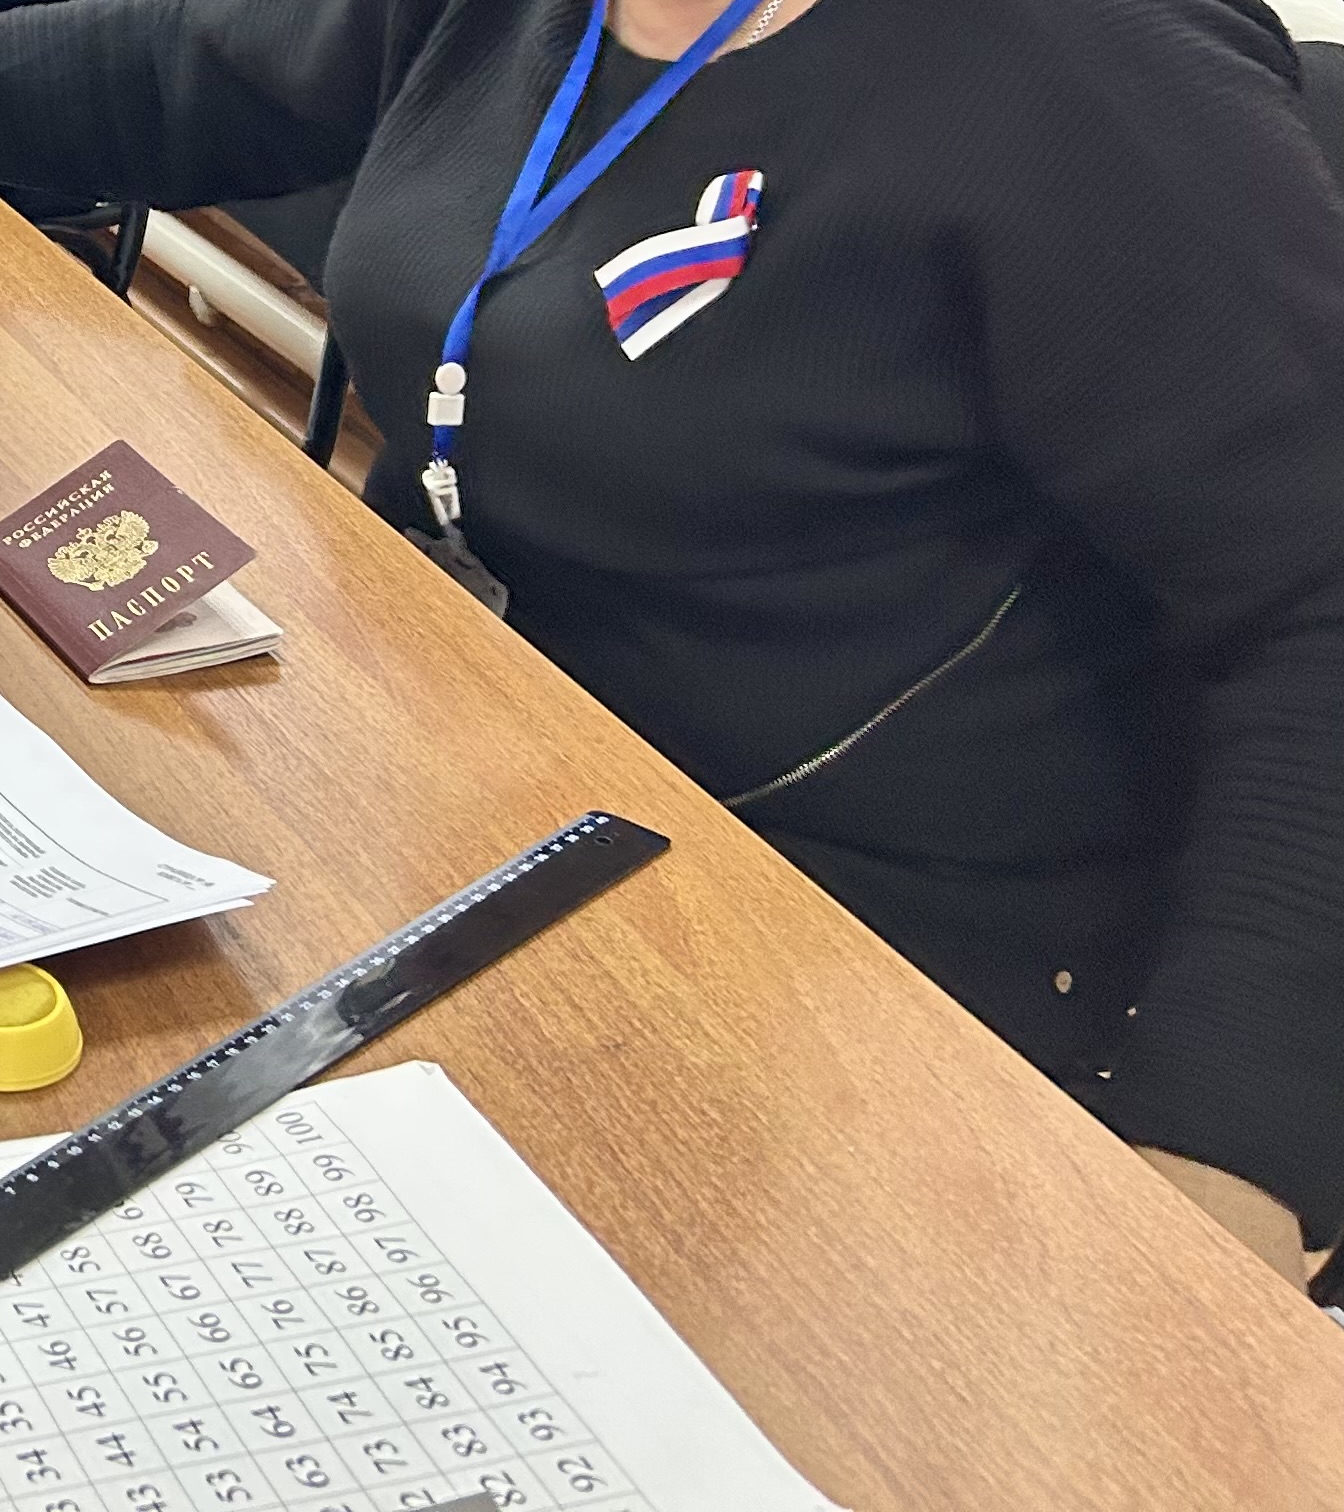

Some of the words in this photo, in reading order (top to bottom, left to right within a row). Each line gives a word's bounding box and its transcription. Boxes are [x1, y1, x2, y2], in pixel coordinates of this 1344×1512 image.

[2, 469, 113, 546] РОССИЙСКАЯ
[18, 482, 115, 548] ФЕДЕРАЦИЯ
[87, 551, 216, 642] ПАСПОРТ
[218, 1130, 255, 1155] 90
[275, 1112, 325, 1145] 100
[244, 1170, 284, 1197] 89
[312, 1154, 356, 1182] 99
[112, 1200, 144, 1221] 6
[174, 1182, 215, 1209] 79
[342, 1192, 387, 1223] 98
[202, 1219, 243, 1248] 78
[273, 1208, 315, 1236] 88
[60, 1246, 101, 1274] 58
[132, 1232, 172, 1260] 68
[373, 1236, 421, 1264] 97
[231, 1262, 273, 1288] 77
[303, 1249, 347, 1275] 87
[86, 1289, 129, 1314] 57
[160, 1274, 201, 1301] 67
[334, 1286, 380, 1316] 86
[406, 1273, 455, 1304] 96
[13, 1302, 51, 1328] 47
[186, 1312, 232, 1343] 66
[261, 1299, 305, 1331] 76
[112, 1327, 158, 1357] 56
[368, 1329, 414, 1362] 85
[442, 1316, 490, 1349] 95
[37, 1340, 77, 1371] 46
[293, 1342, 338, 1377] 75
[142, 1372, 189, 1403] 55
[219, 1357, 263, 1389] 65
[478, 1362, 528, 1395] 94
[66, 1386, 107, 1417] 45
[326, 1391, 374, 1424] 74
[404, 1377, 450, 1410] 84
[173, 1419, 220, 1452] 54
[250, 1405, 296, 1438] 64
[517, 1407, 567, 1442] 93
[95, 1432, 136, 1468] 44
[441, 1423, 488, 1457] 83
[16, 1448, 62, 1483] 34
[285, 1455, 330, 1488] 63
[363, 1439, 409, 1475] 73
[205, 1469, 254, 1504] 53
[479, 1470, 528, 1508] 82
[557, 1456, 609, 1493] 92
[399, 1487, 437, 1507] 2
